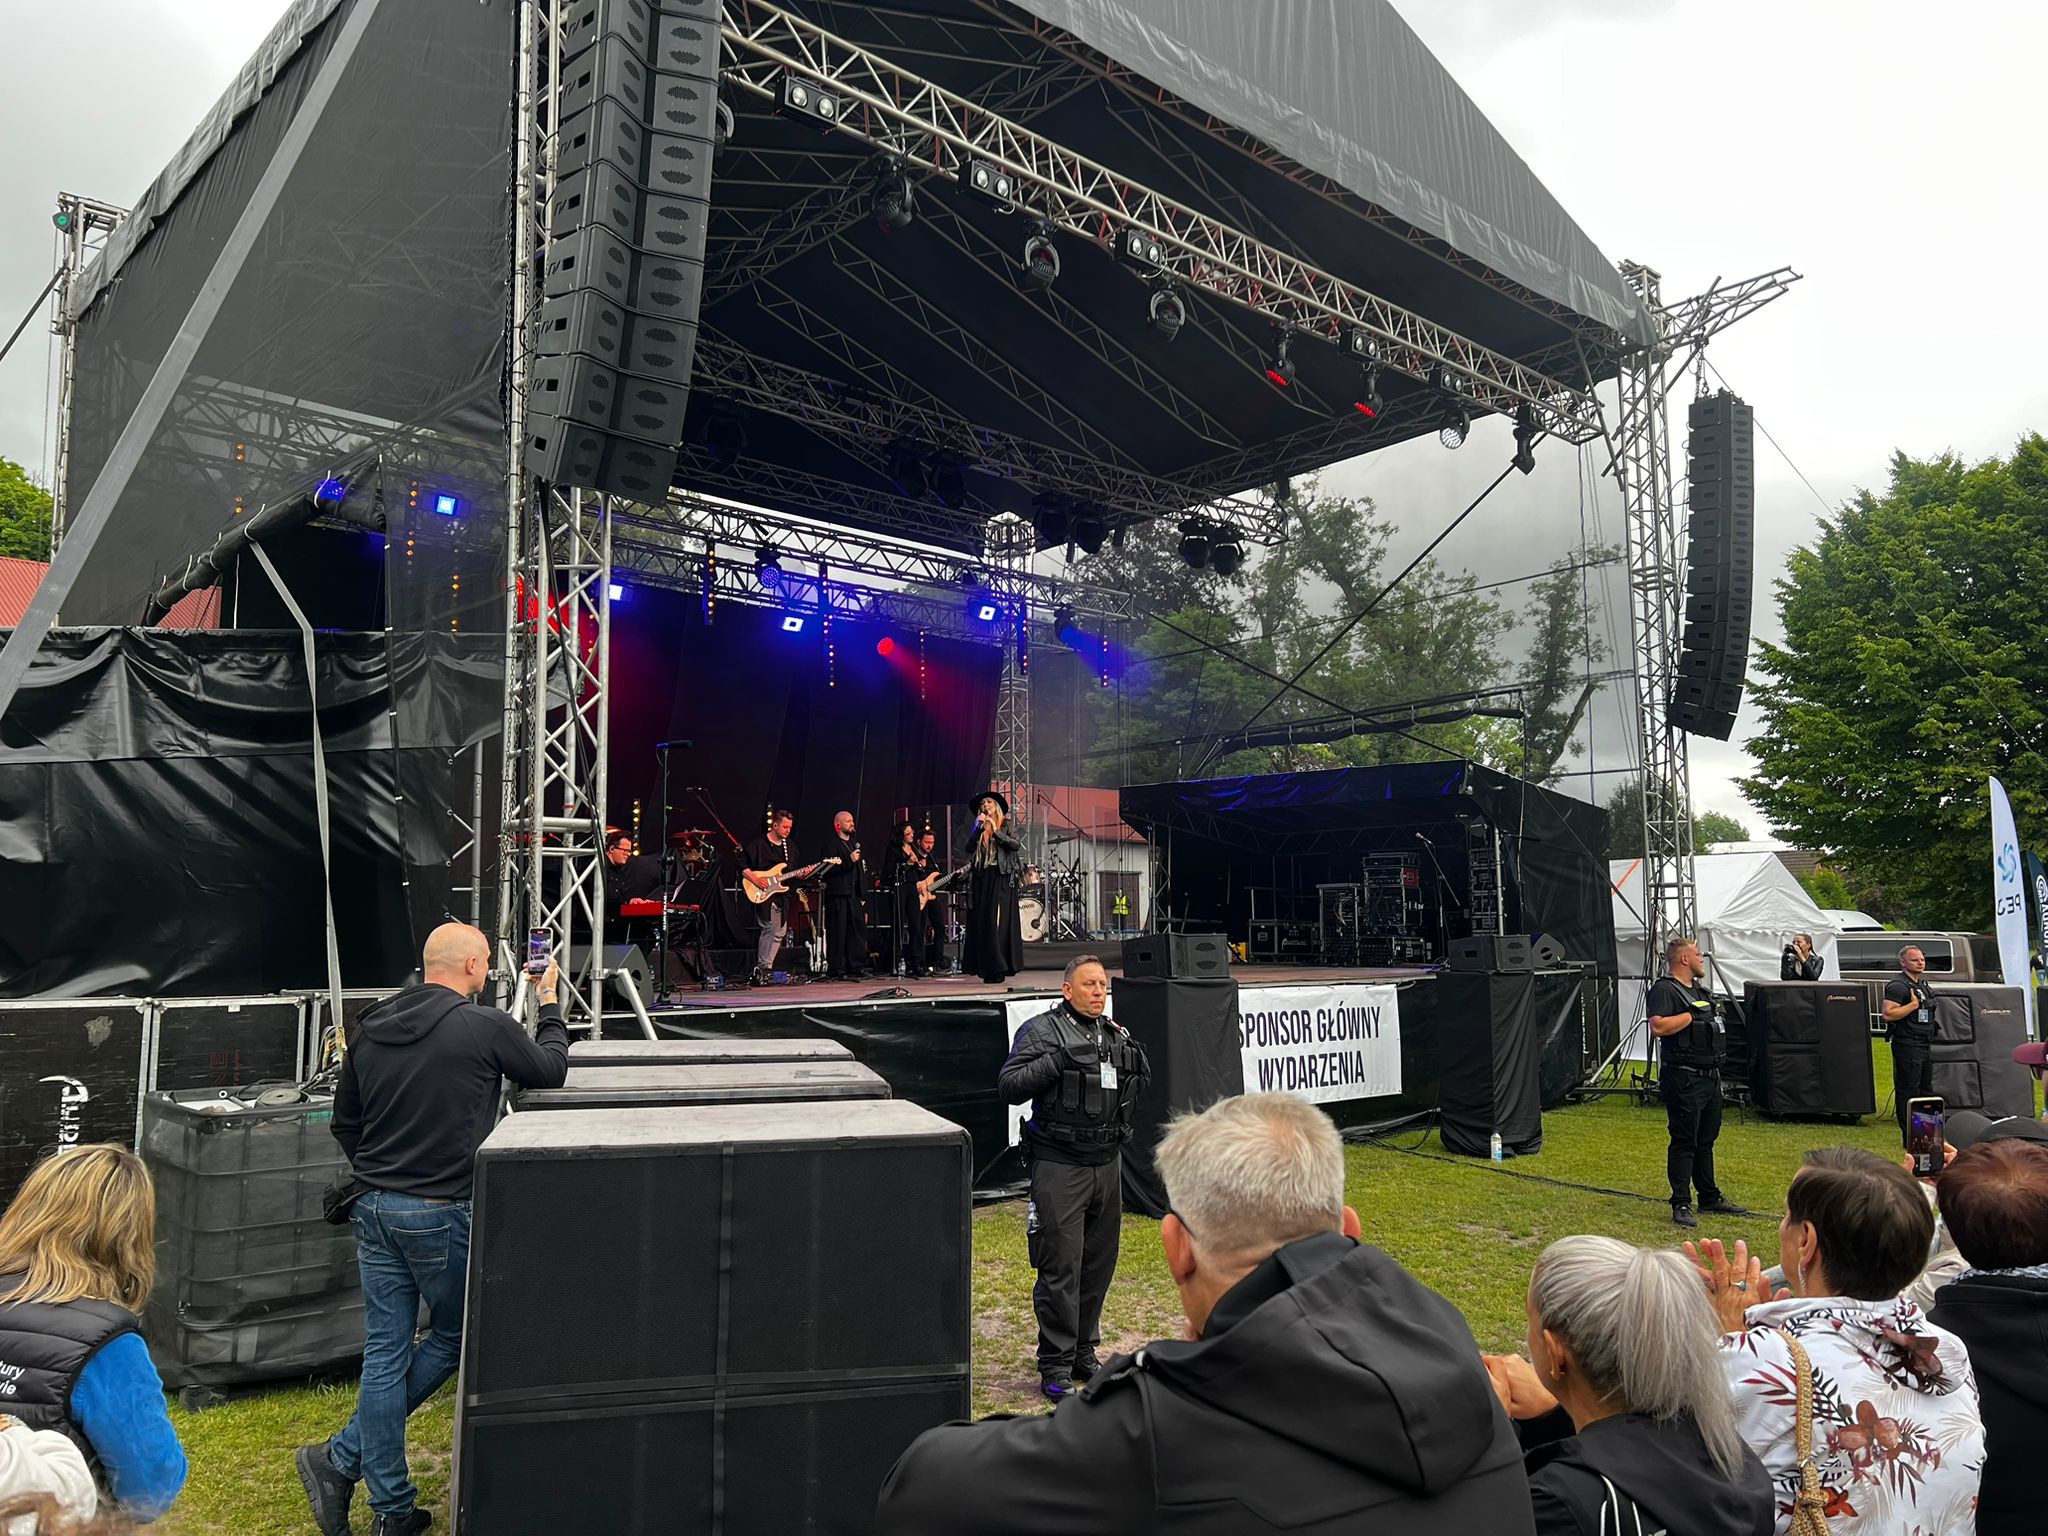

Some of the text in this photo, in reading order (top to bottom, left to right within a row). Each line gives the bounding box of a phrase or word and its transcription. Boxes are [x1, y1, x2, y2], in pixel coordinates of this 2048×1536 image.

[1238, 1001, 1381, 1049] SPONSOR GŁÓWNY
[1258, 1050, 1366, 1093] WYDARZENIA
